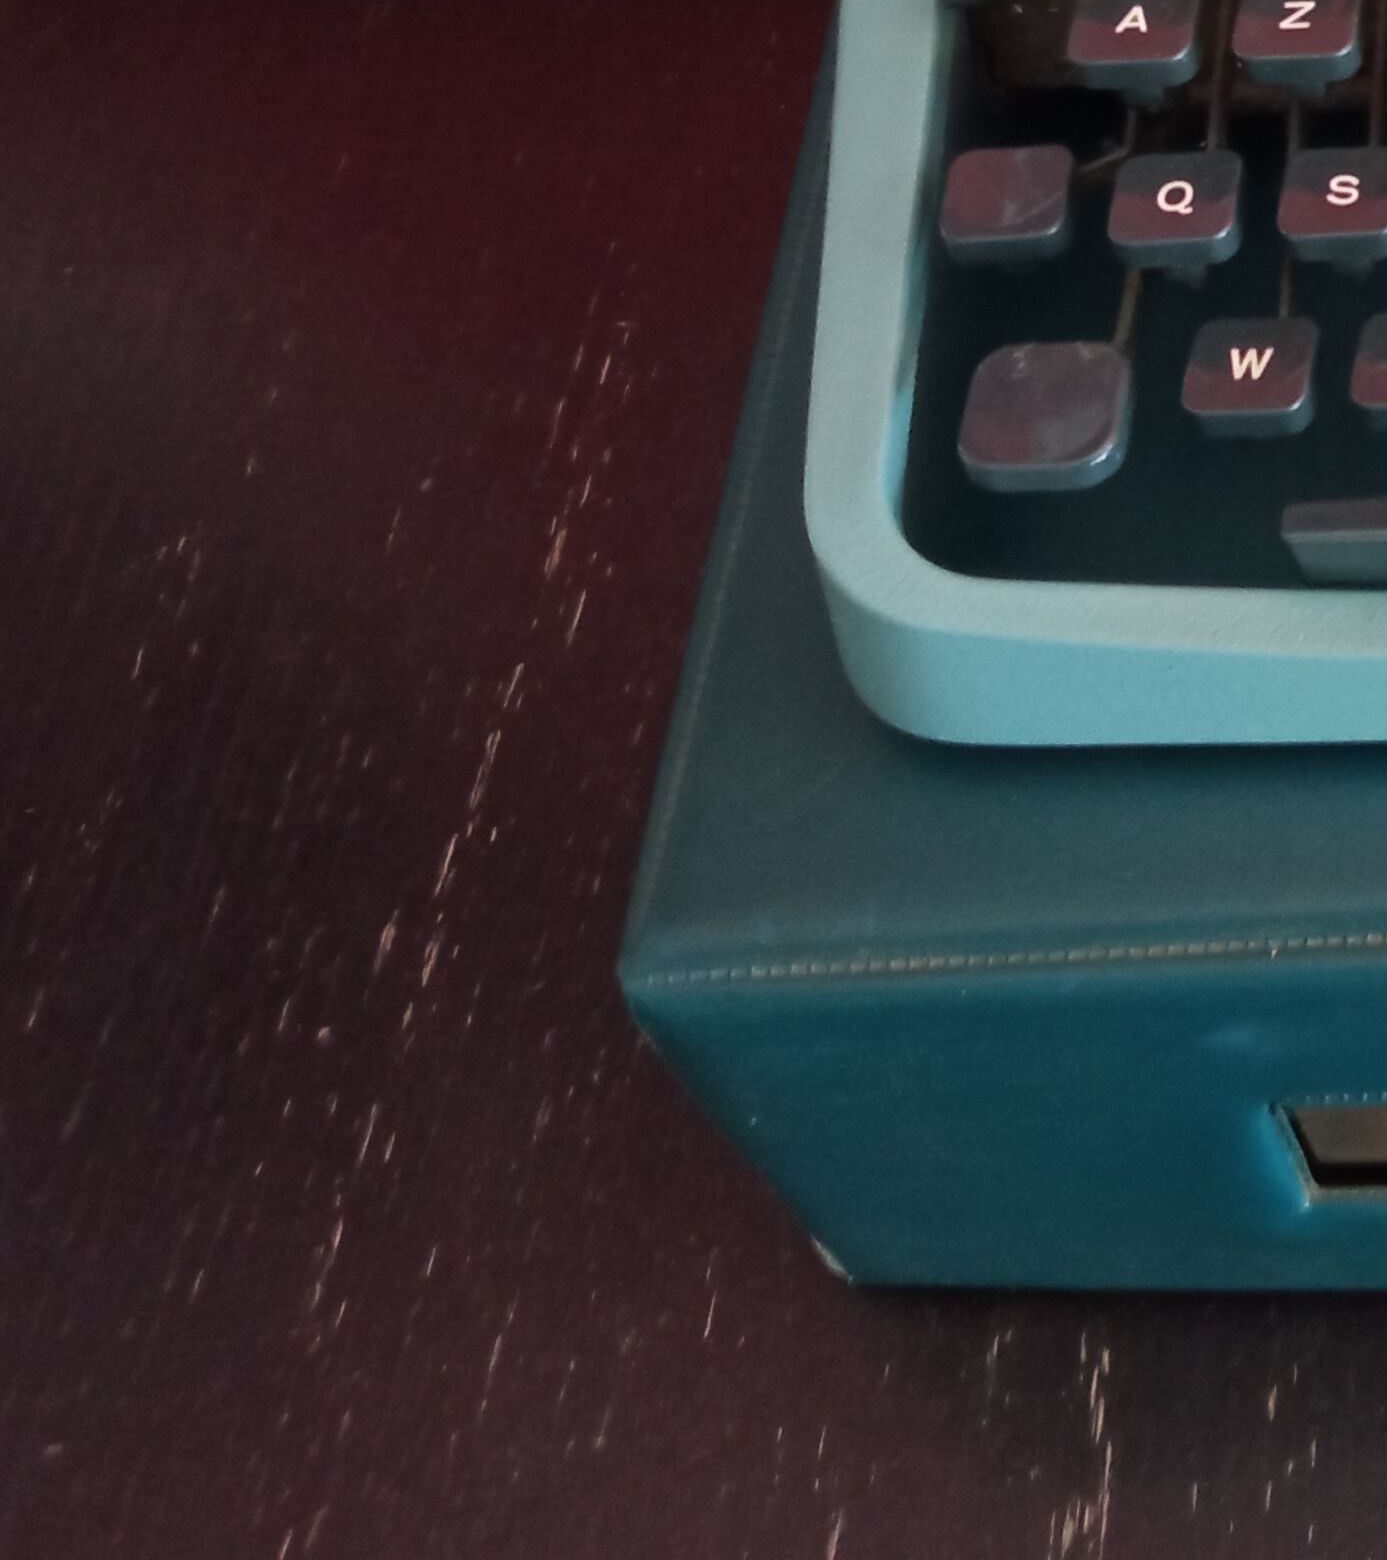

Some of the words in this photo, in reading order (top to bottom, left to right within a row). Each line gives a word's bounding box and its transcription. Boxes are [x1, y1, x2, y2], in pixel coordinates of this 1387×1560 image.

[1116, 6, 1147, 32] A
[1280, 1, 1315, 29] Z
[1158, 181, 1193, 214] Q
[1327, 175, 1359, 205] S
[1231, 348, 1273, 379] W
